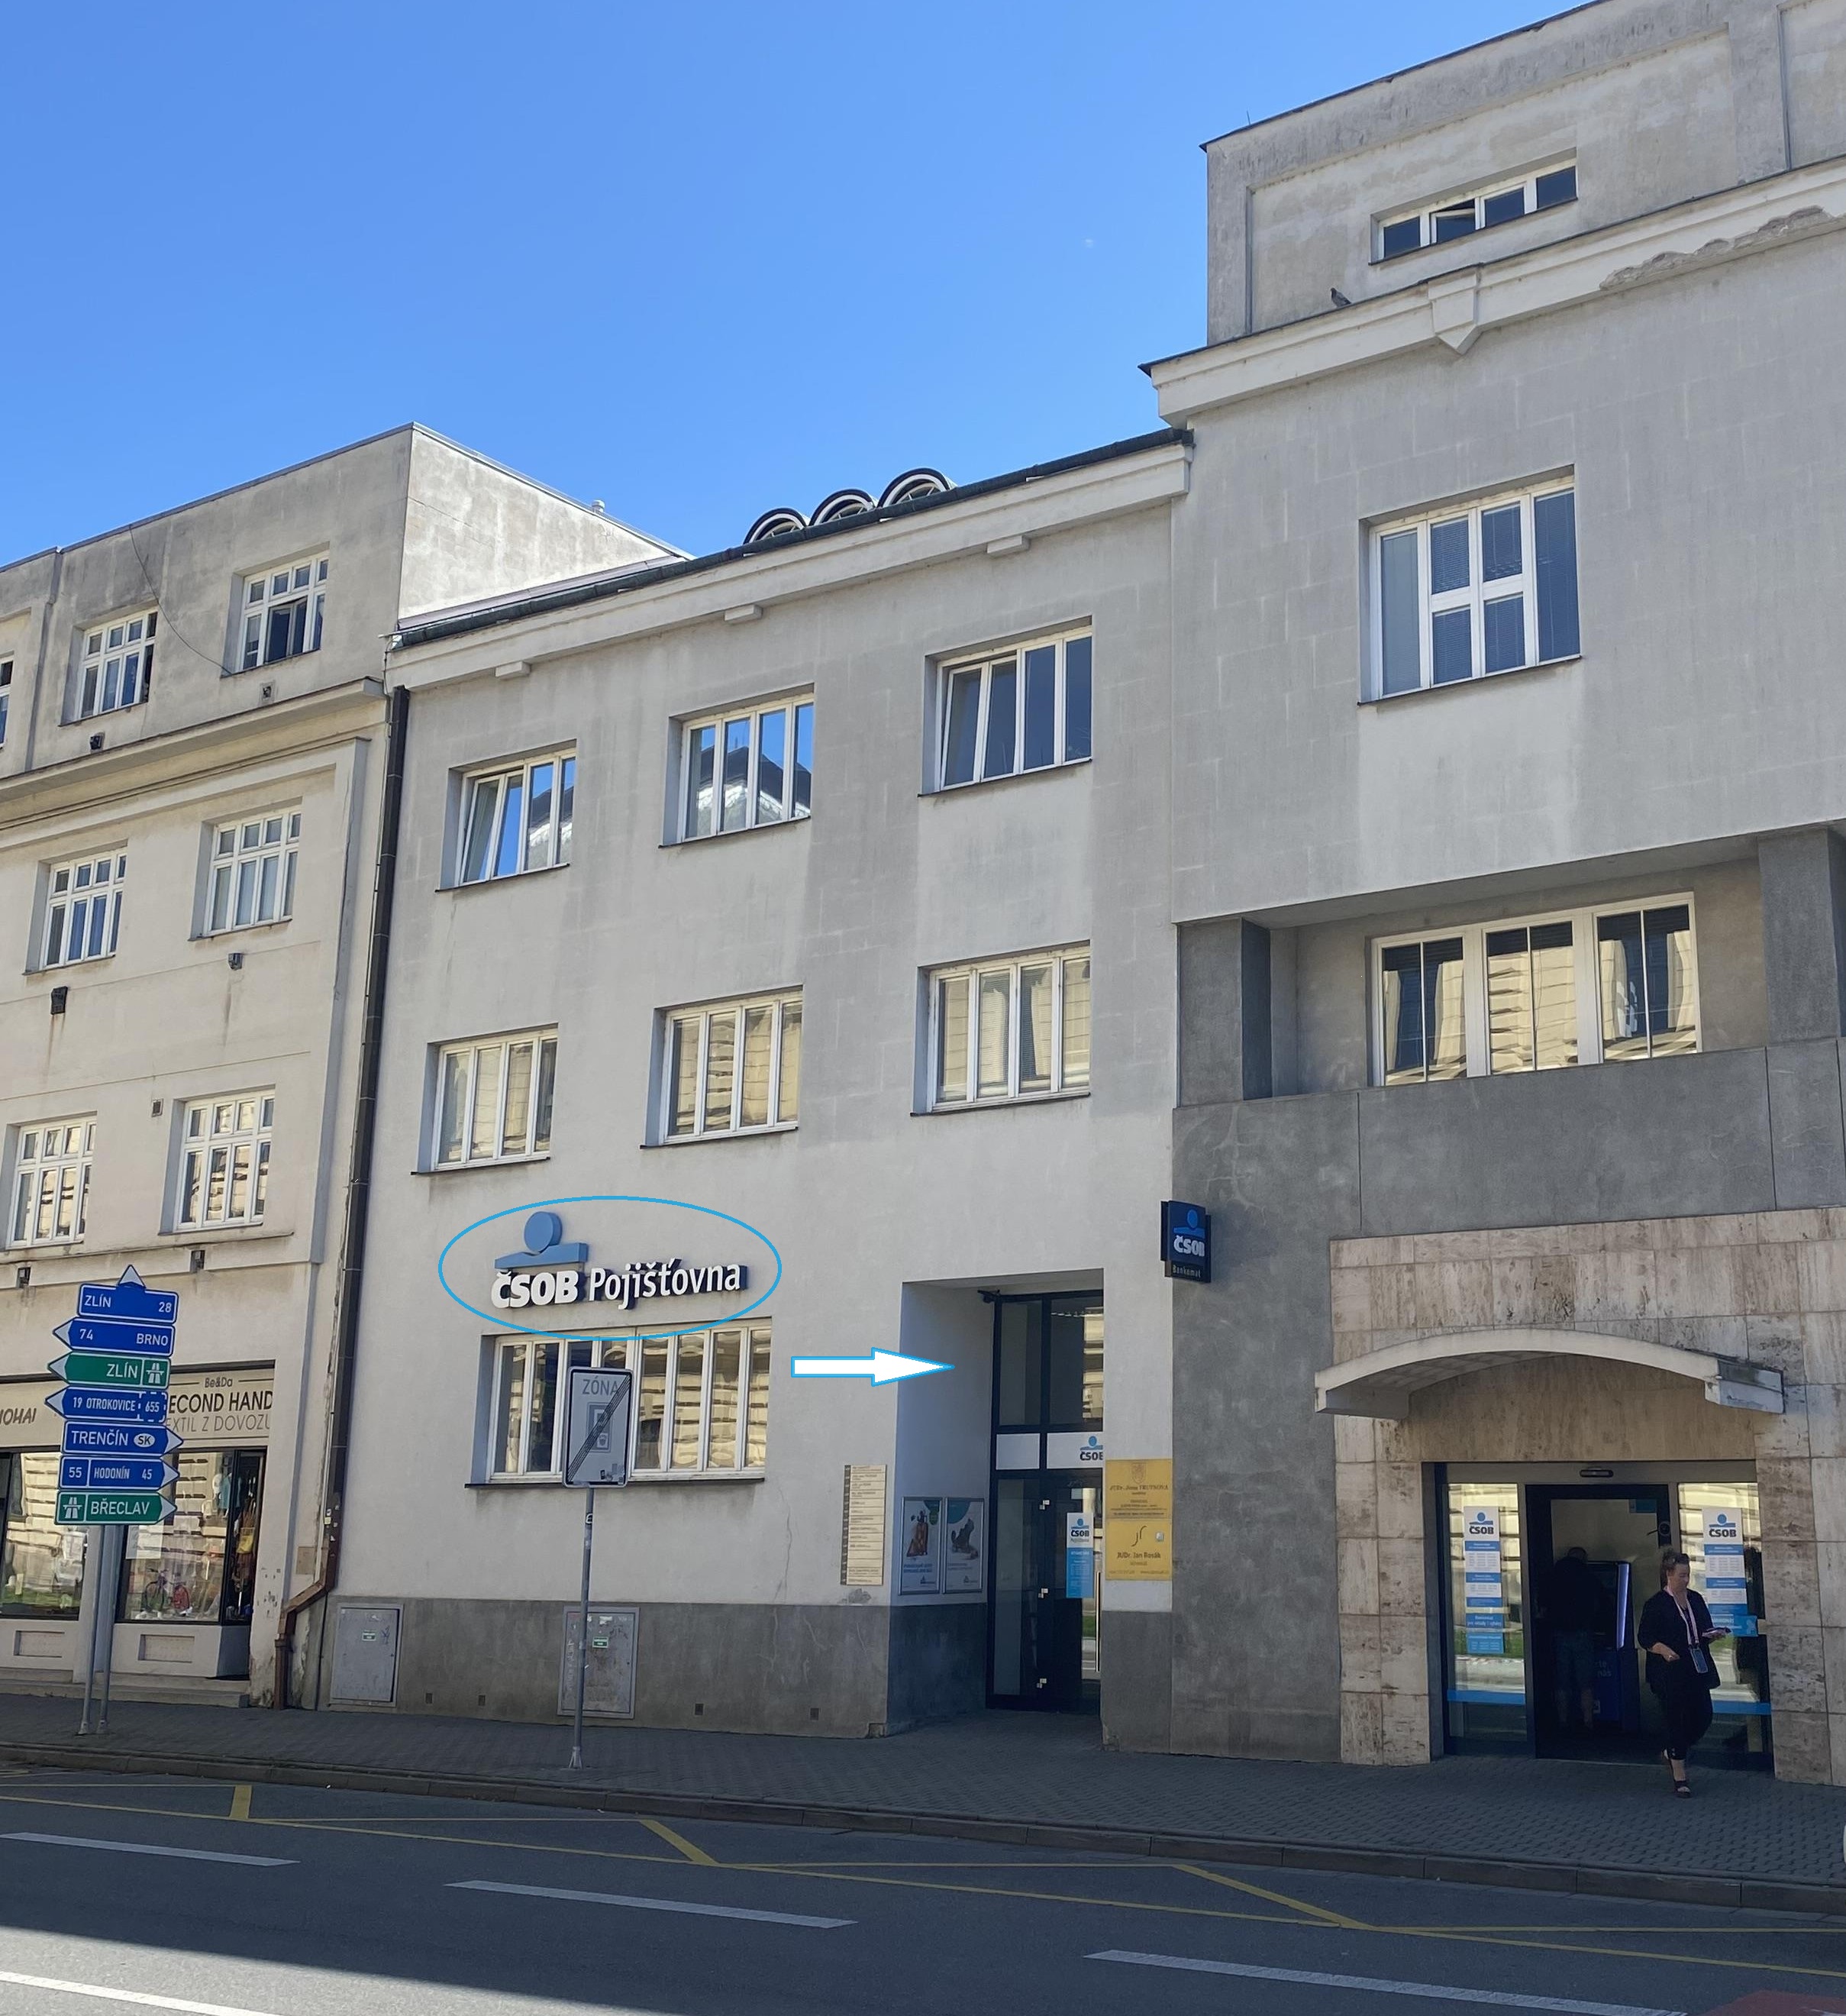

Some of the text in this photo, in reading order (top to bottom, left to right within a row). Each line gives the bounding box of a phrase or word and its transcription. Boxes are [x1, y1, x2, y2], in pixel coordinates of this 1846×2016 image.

[1173, 1235, 1205, 1257] ČSOB
[491, 1258, 742, 1310] ČSOB Pojišťovna
[84, 1294, 172, 1313] ZLÍN 28
[79, 1329, 169, 1346] 74 BRNO
[106, 1362, 138, 1378] ZLÍN
[582, 1376, 620, 1396] ZÓNA
[73, 1397, 160, 1413] 19 OTROKOVICE 655
[169, 1391, 273, 1413] ECOND HAND
[202, 1416, 209, 1431] Z
[71, 1429, 151, 1446] TRENČÍN SK
[69, 1465, 153, 1480] 55 HODONÍN 45
[90, 1497, 150, 1515] BŘECLAV
[1469, 1526, 1494, 1535] ČSOB
[1709, 1528, 1737, 1538] ČSOB
